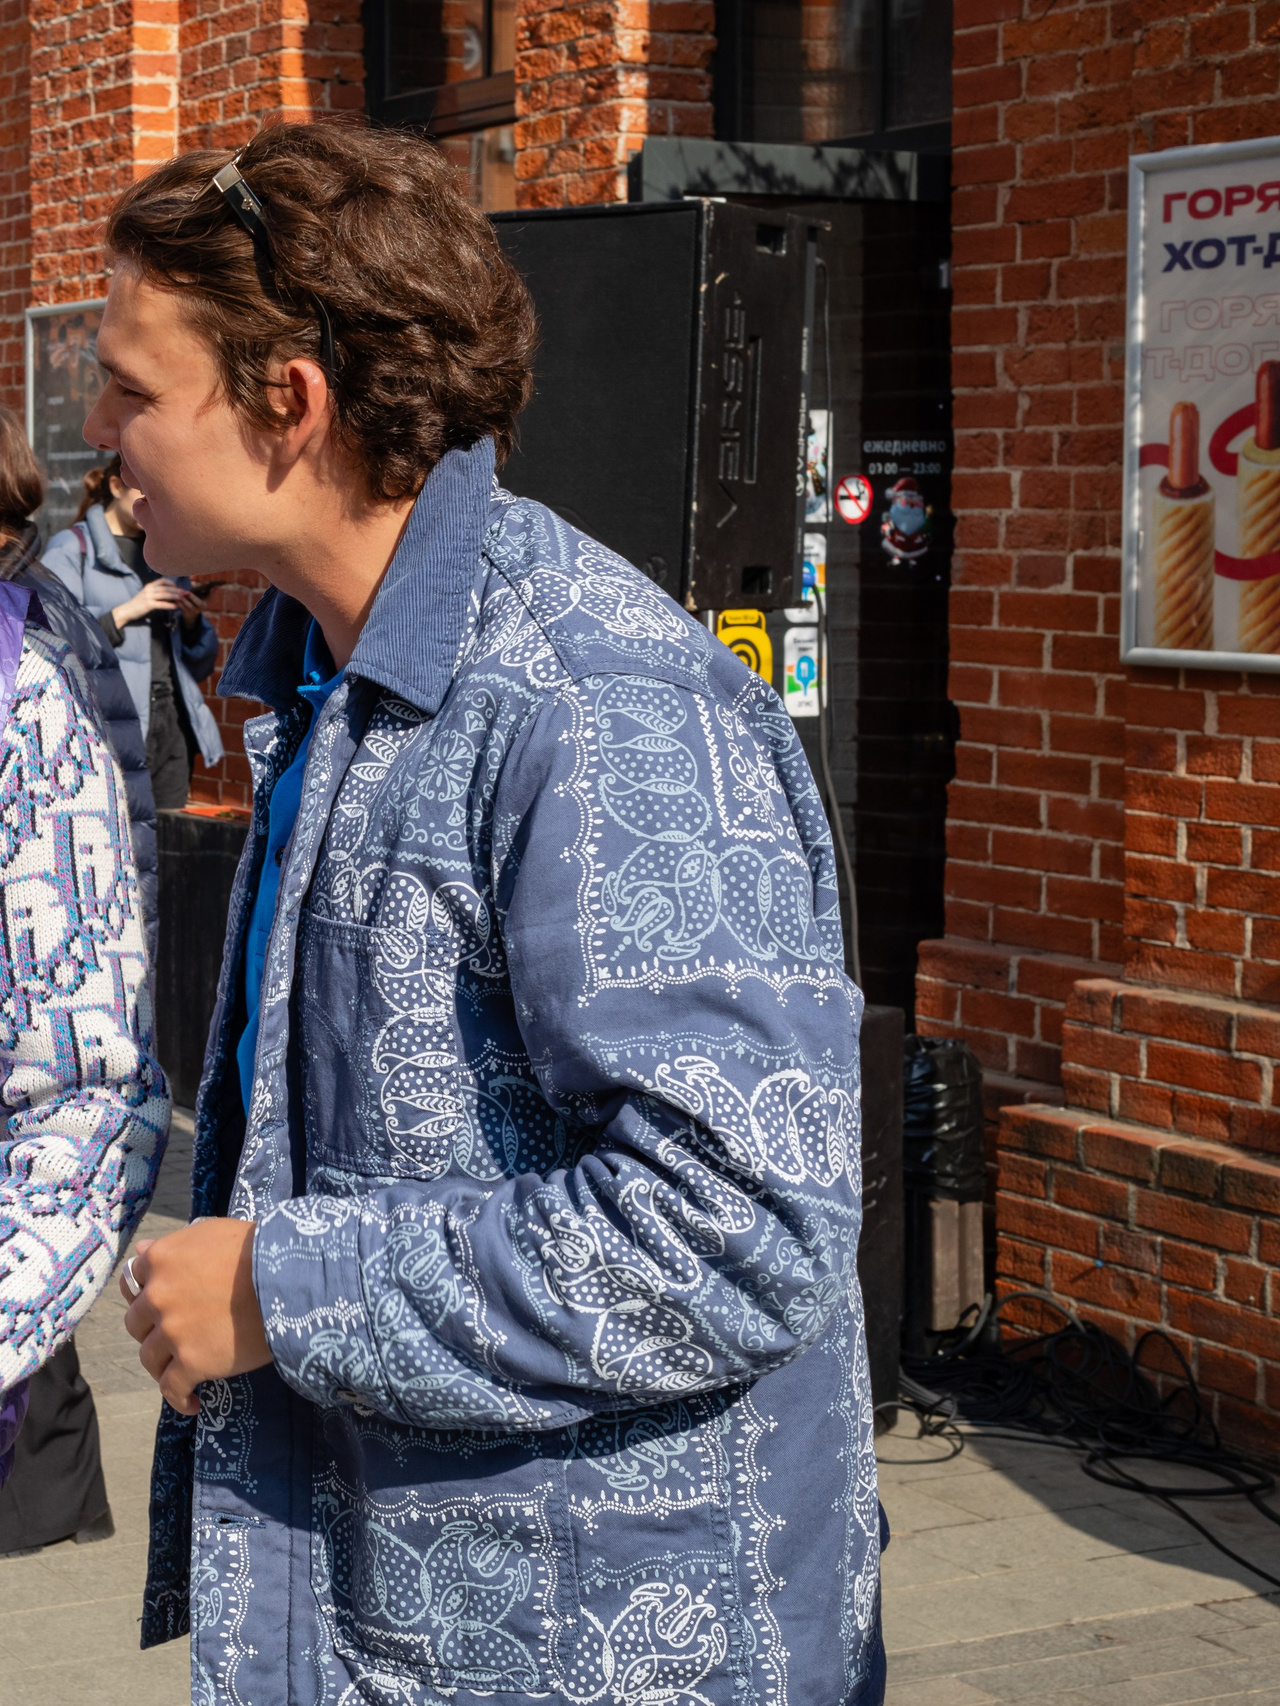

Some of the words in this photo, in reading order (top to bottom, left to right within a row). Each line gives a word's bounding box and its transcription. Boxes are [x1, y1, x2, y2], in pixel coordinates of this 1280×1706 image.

[1163, 180, 1280, 223] ГОРЯ
[1142, 341, 1280, 383] Т-ДОГ
[863, 440, 946, 456] ежедневно
